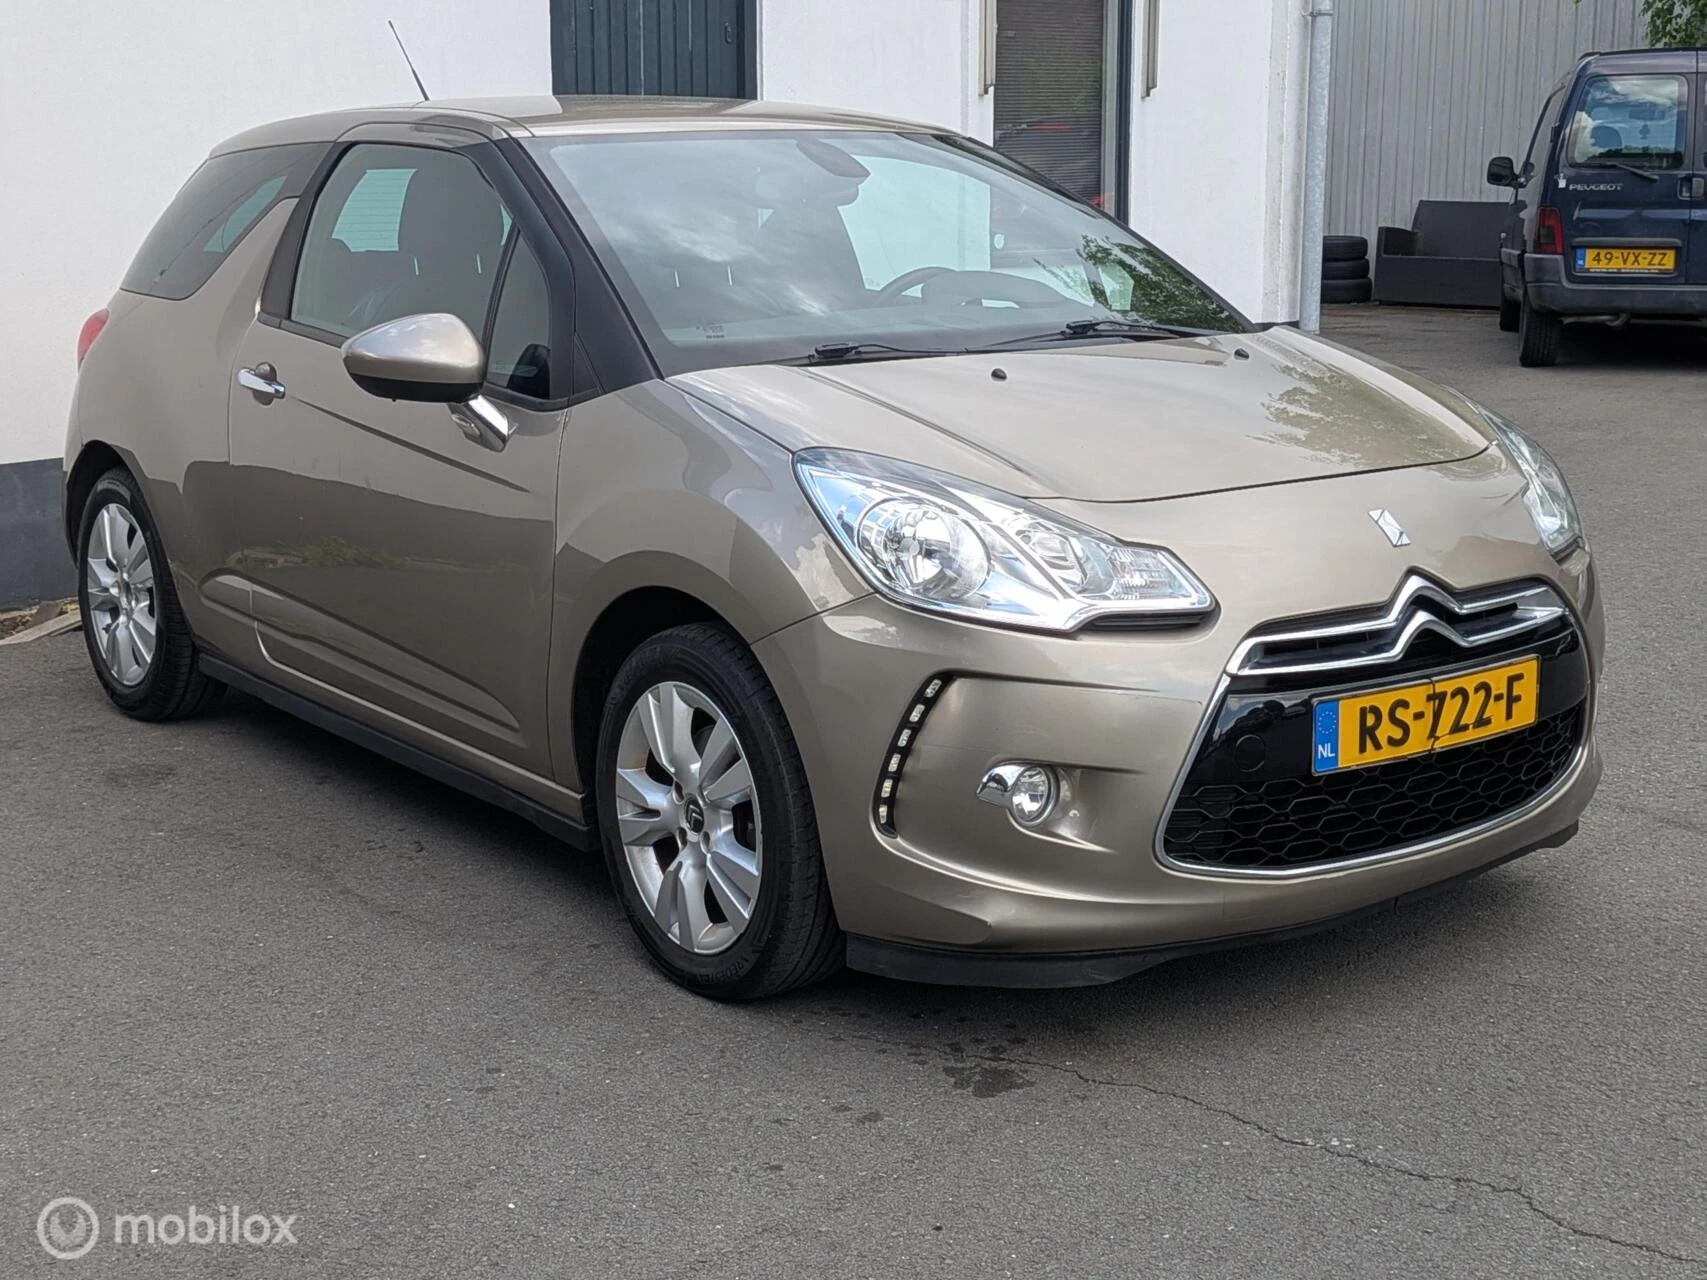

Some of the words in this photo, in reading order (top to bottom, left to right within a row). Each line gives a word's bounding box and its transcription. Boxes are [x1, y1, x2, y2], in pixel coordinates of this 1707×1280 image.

[1569, 183, 1623, 191] PEUGEOT
[1592, 251, 1667, 266] 49-VX-ZZ
[1318, 743, 1336, 758] NL
[1358, 672, 1525, 754] RS-722-F
